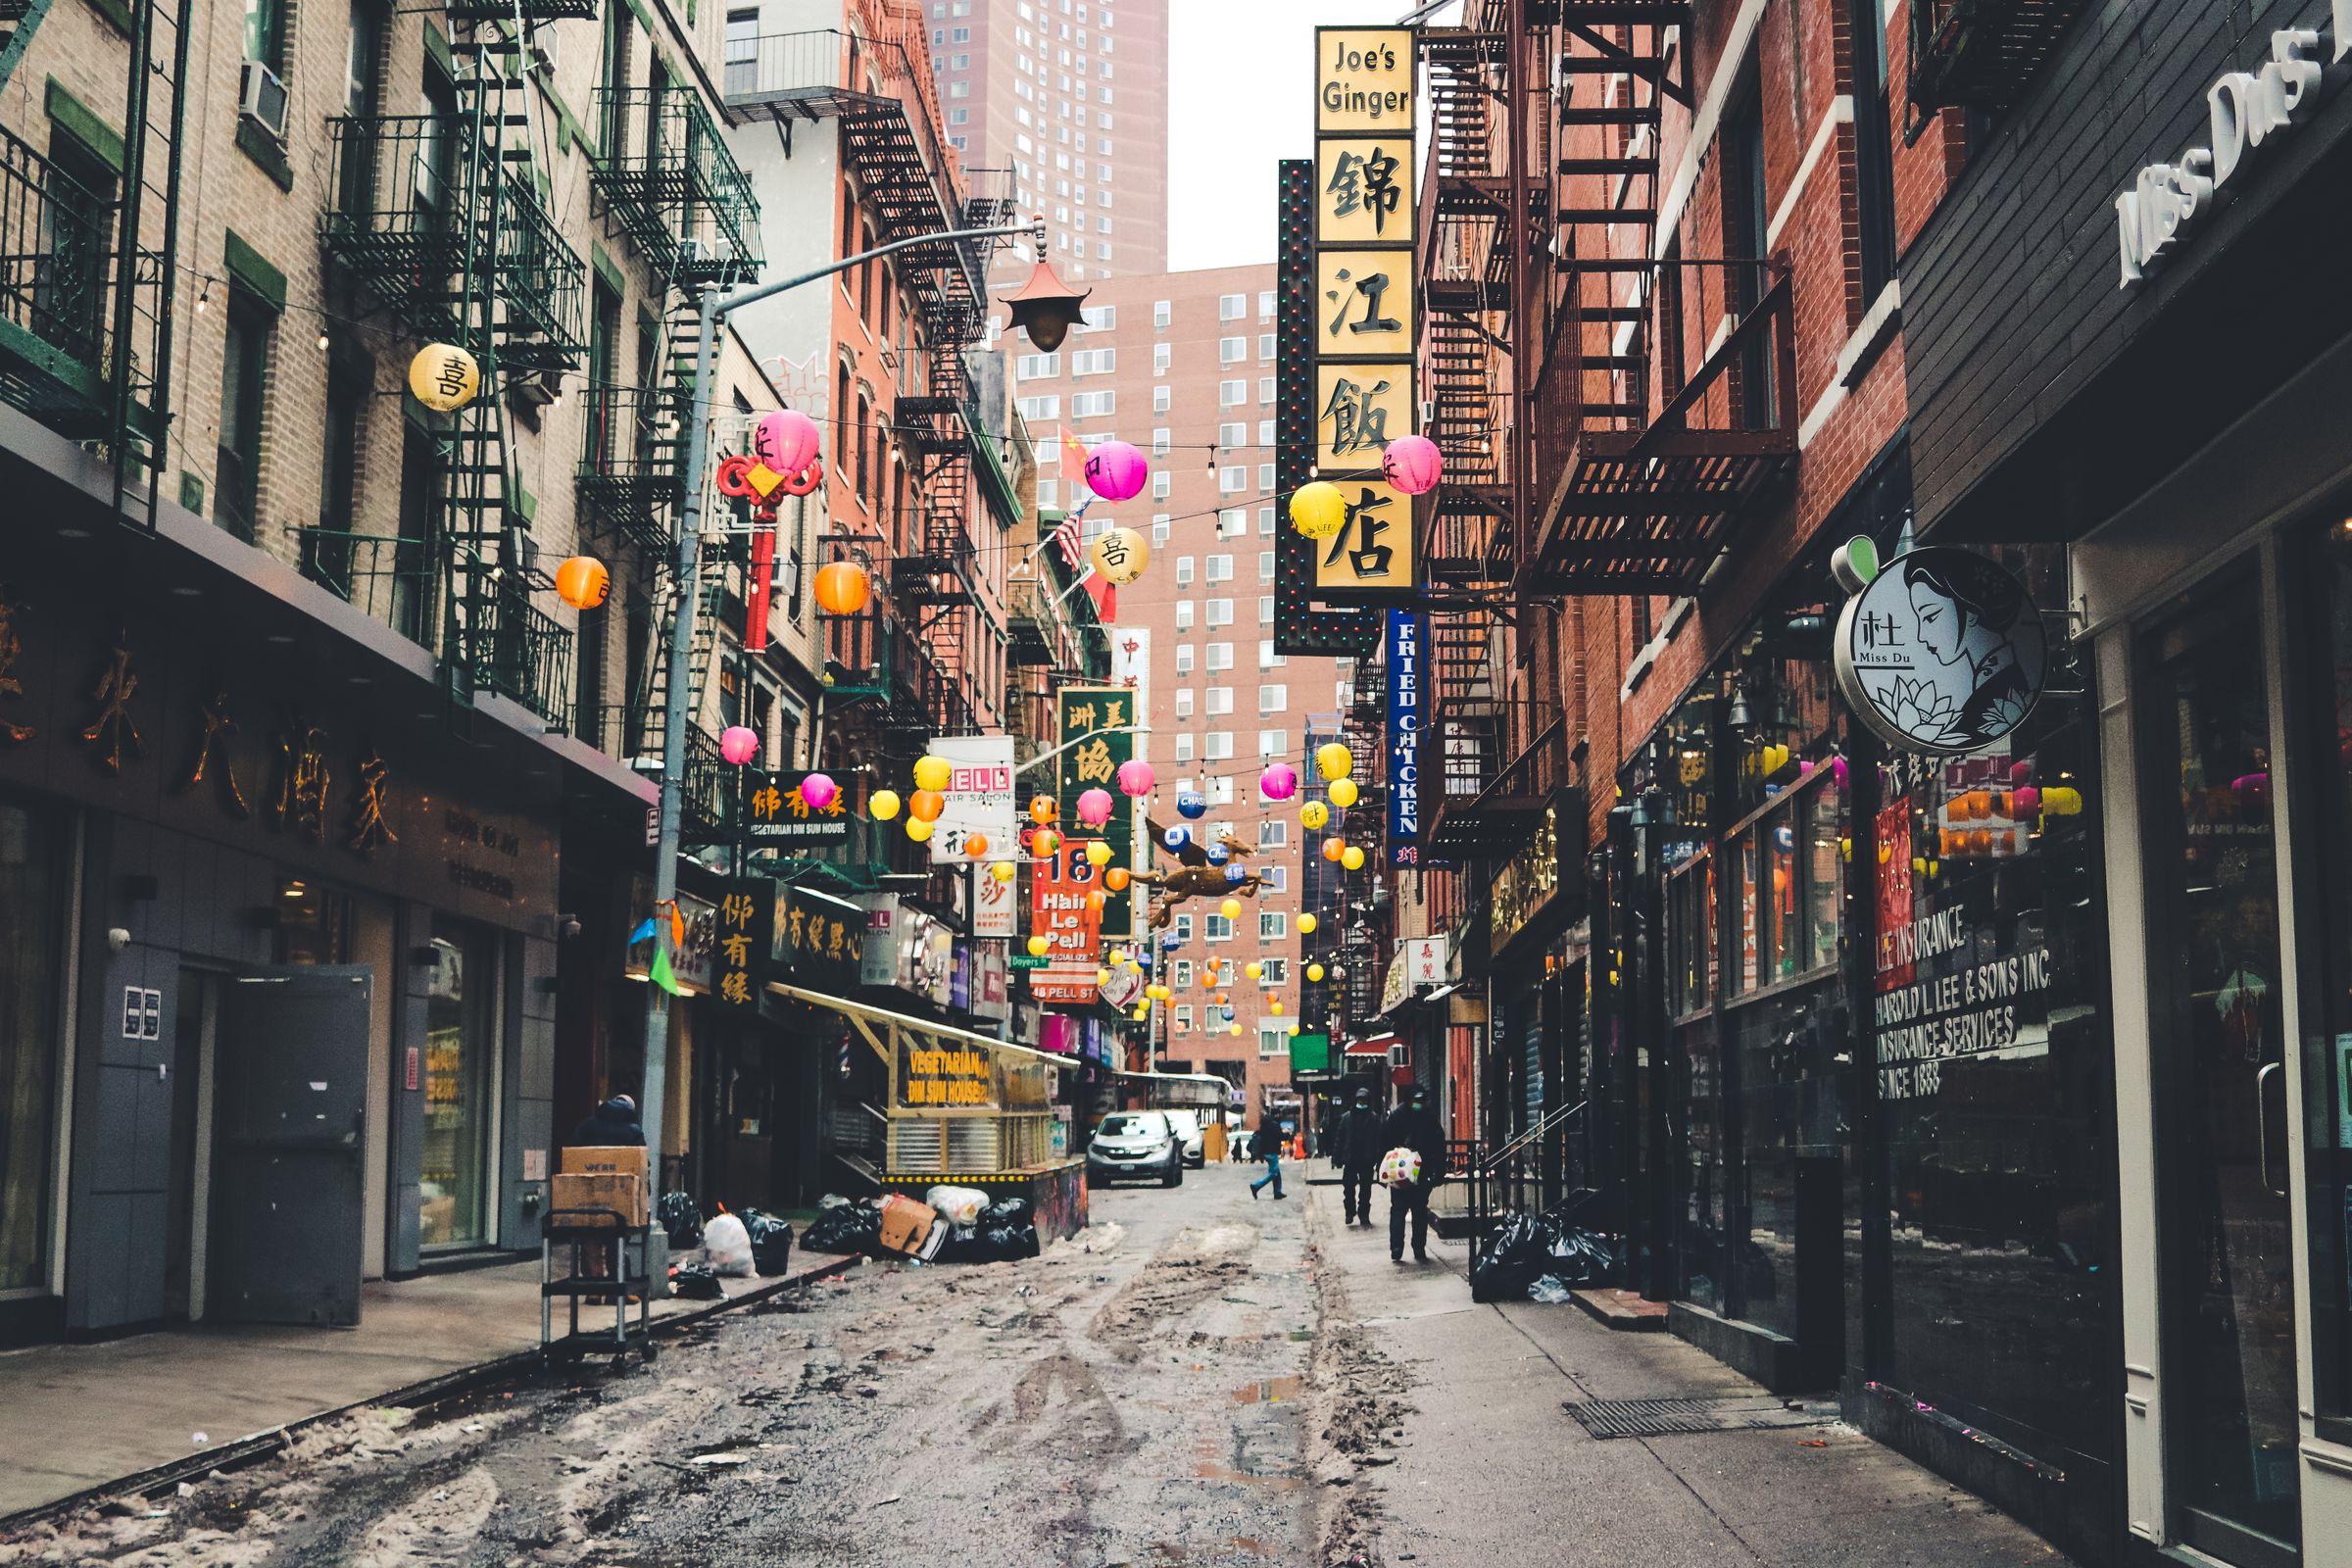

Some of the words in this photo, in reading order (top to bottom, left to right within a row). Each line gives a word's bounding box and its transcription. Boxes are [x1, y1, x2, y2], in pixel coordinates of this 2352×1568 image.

[1335, 41, 1396, 72] Joe's
[1323, 81, 1409, 119] Ginger
[2116, 149, 2212, 289] Miss
[436, 355, 468, 398] 喜
[1319, 146, 1403, 580] 錦江飯店
[1102, 532, 1129, 566] 喜
[1860, 611, 1905, 650] 杜
[1397, 623, 1416, 707] FRIED
[1859, 653, 1887, 663] Miss
[1892, 653, 1910, 663] Du
[951, 768, 1009, 791] ELL
[1397, 714, 1418, 833] CHICKEN
[970, 793, 1010, 803] SALON
[751, 824, 792, 836] VEGETARIAN
[793, 823, 805, 835] DIM
[807, 823, 821, 834] SUM
[822, 822, 846, 834] HOUSE
[1048, 847, 1095, 883] 18
[1043, 893, 1088, 910] Hair
[1051, 911, 1079, 929] Le
[1045, 931, 1087, 949] Pell
[1876, 930, 1894, 973] LEE
[1896, 904, 1966, 966] INSURANCE
[1012, 957, 1039, 968] Doyers
[1033, 987, 1046, 998] 18
[1049, 988, 1077, 998] PELL
[1080, 988, 1095, 998] ST
[1875, 987, 1920, 1027] HAROLD
[1936, 973, 1961, 1012] LEE
[1965, 968, 1976, 1005] &
[1978, 956, 2018, 1004] SONS
[1876, 1021, 1941, 1064] INSURANCE
[1944, 1004, 2018, 1057] SERVICES
[909, 1051, 980, 1074] VEGETARIAN
[907, 1080, 925, 1103] DIM
[926, 1080, 947, 1103] SUM
[948, 1080, 979, 1103] HOUSE
[1877, 1066, 1911, 1101] SINCE
[1912, 1061, 1941, 1099] 1888
